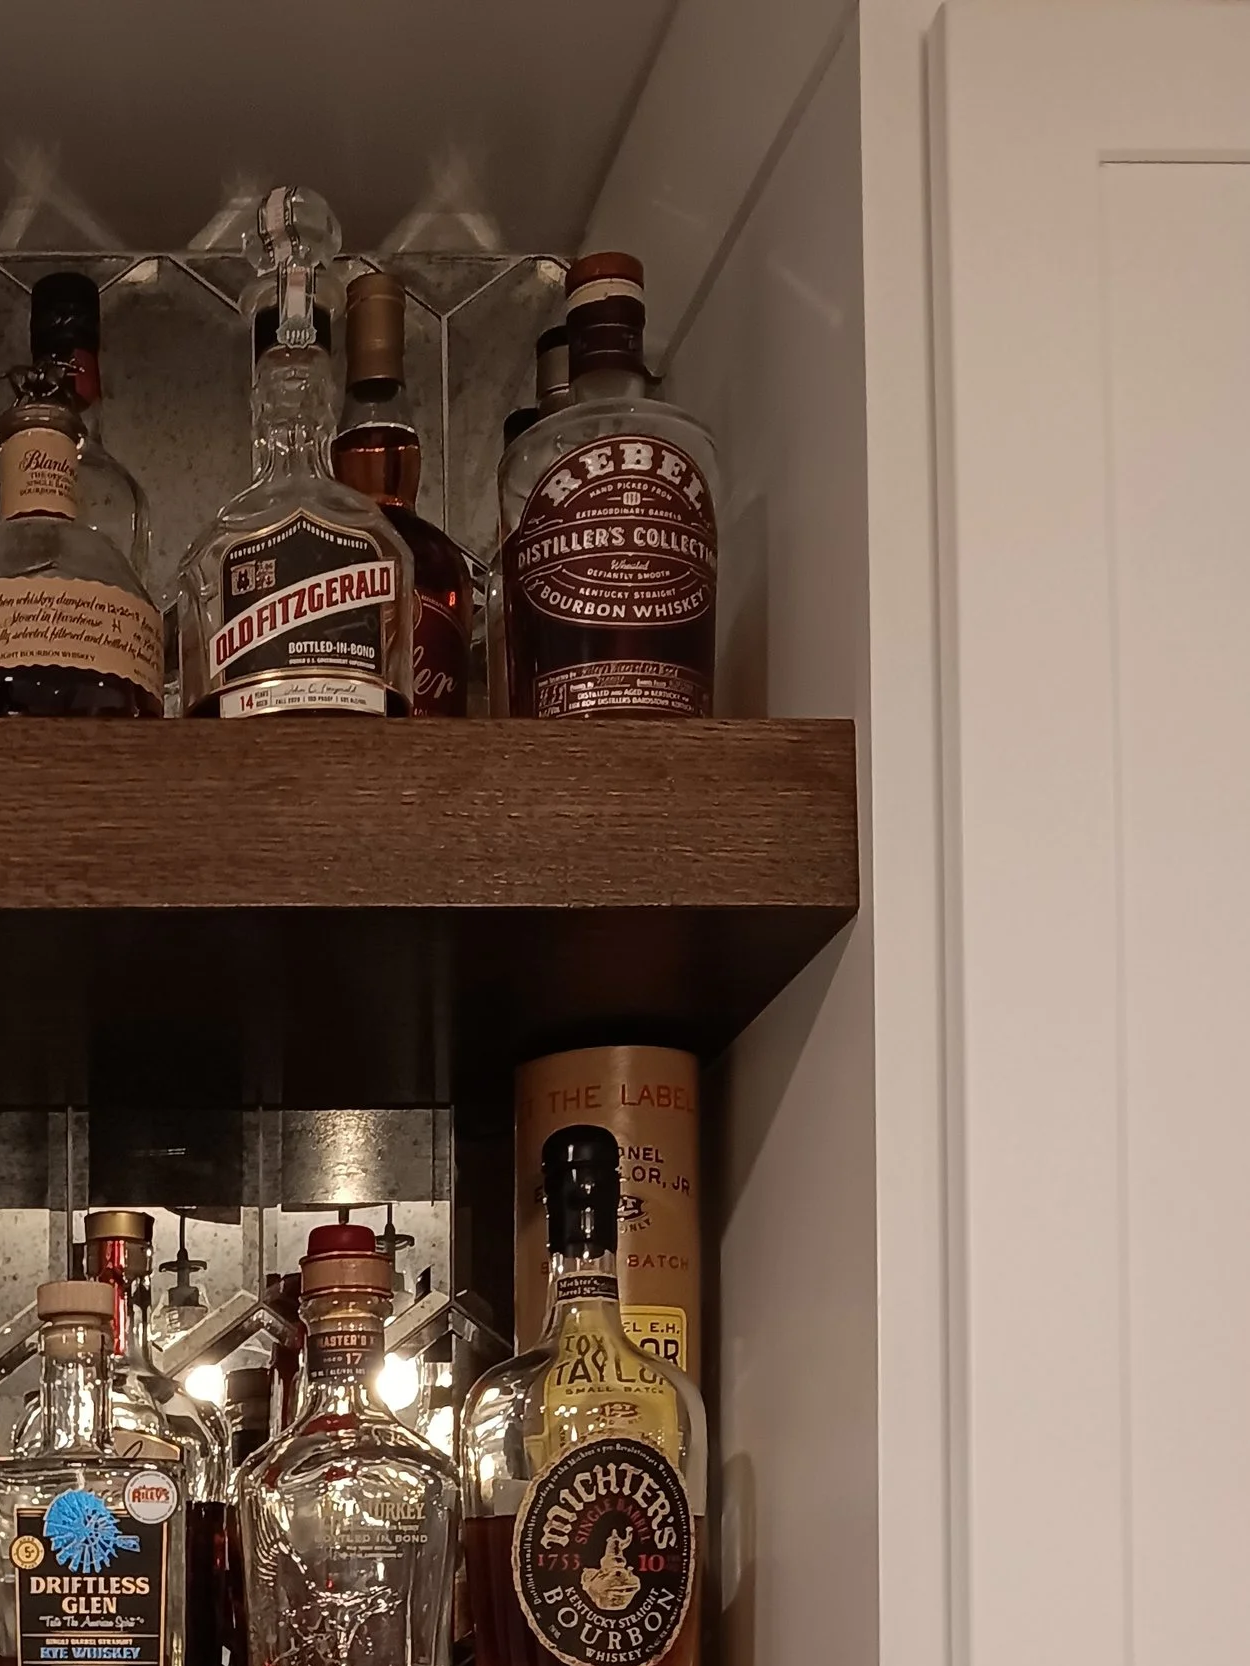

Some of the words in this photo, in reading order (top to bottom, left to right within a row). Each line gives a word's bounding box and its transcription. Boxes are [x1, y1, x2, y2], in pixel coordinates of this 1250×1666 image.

[541, 443, 704, 509] REBEL
[590, 484, 613, 498] HAND
[617, 482, 649, 491] PICKED
[651, 486, 673, 501] FROM
[576, 508, 645, 520] EXTRAORDINARY
[649, 510, 682, 521] BARRELS
[518, 526, 626, 569] DISTILLER'S
[587, 568, 633, 580] DEFIANTLY
[637, 570, 670, 580] SMOOTH
[540, 585, 626, 618] BOURBON
[633, 588, 705, 618] WHISKEY
[579, 586, 629, 599] KENTUCKY
[634, 588, 676, 599] STRAIGHT
[216, 615, 254, 666] OLD
[256, 566, 391, 638] FITZGERALD
[288, 641, 375, 659] BOTTLED-IN-BOND
[240, 694, 254, 712] 14
[550, 1085, 602, 1113] THE
[621, 1084, 694, 1112] LABEL
[672, 1176, 690, 1195] JR
[627, 1254, 688, 1269] BATCH
[650, 1322, 680, 1334] E.H.
[346, 1353, 362, 1365] 17
[566, 1387, 613, 1395] SMALL
[540, 1462, 678, 1550] MICHTER'S
[575, 1499, 613, 1545] SINGLE
[538, 1554, 581, 1571] 1753
[638, 1554, 665, 1572] 10
[30, 1577, 150, 1595] DRIFTLESS
[61, 1597, 117, 1614] GLEN
[564, 1587, 616, 1629] KENTUCKY
[618, 1588, 660, 1629] STRAIGHT
[543, 1586, 675, 1650] BOURBON
[40, 1646, 69, 1659] RYE
[71, 1646, 141, 1659] WHISKEY
[586, 1647, 642, 1663] WHISKEY
